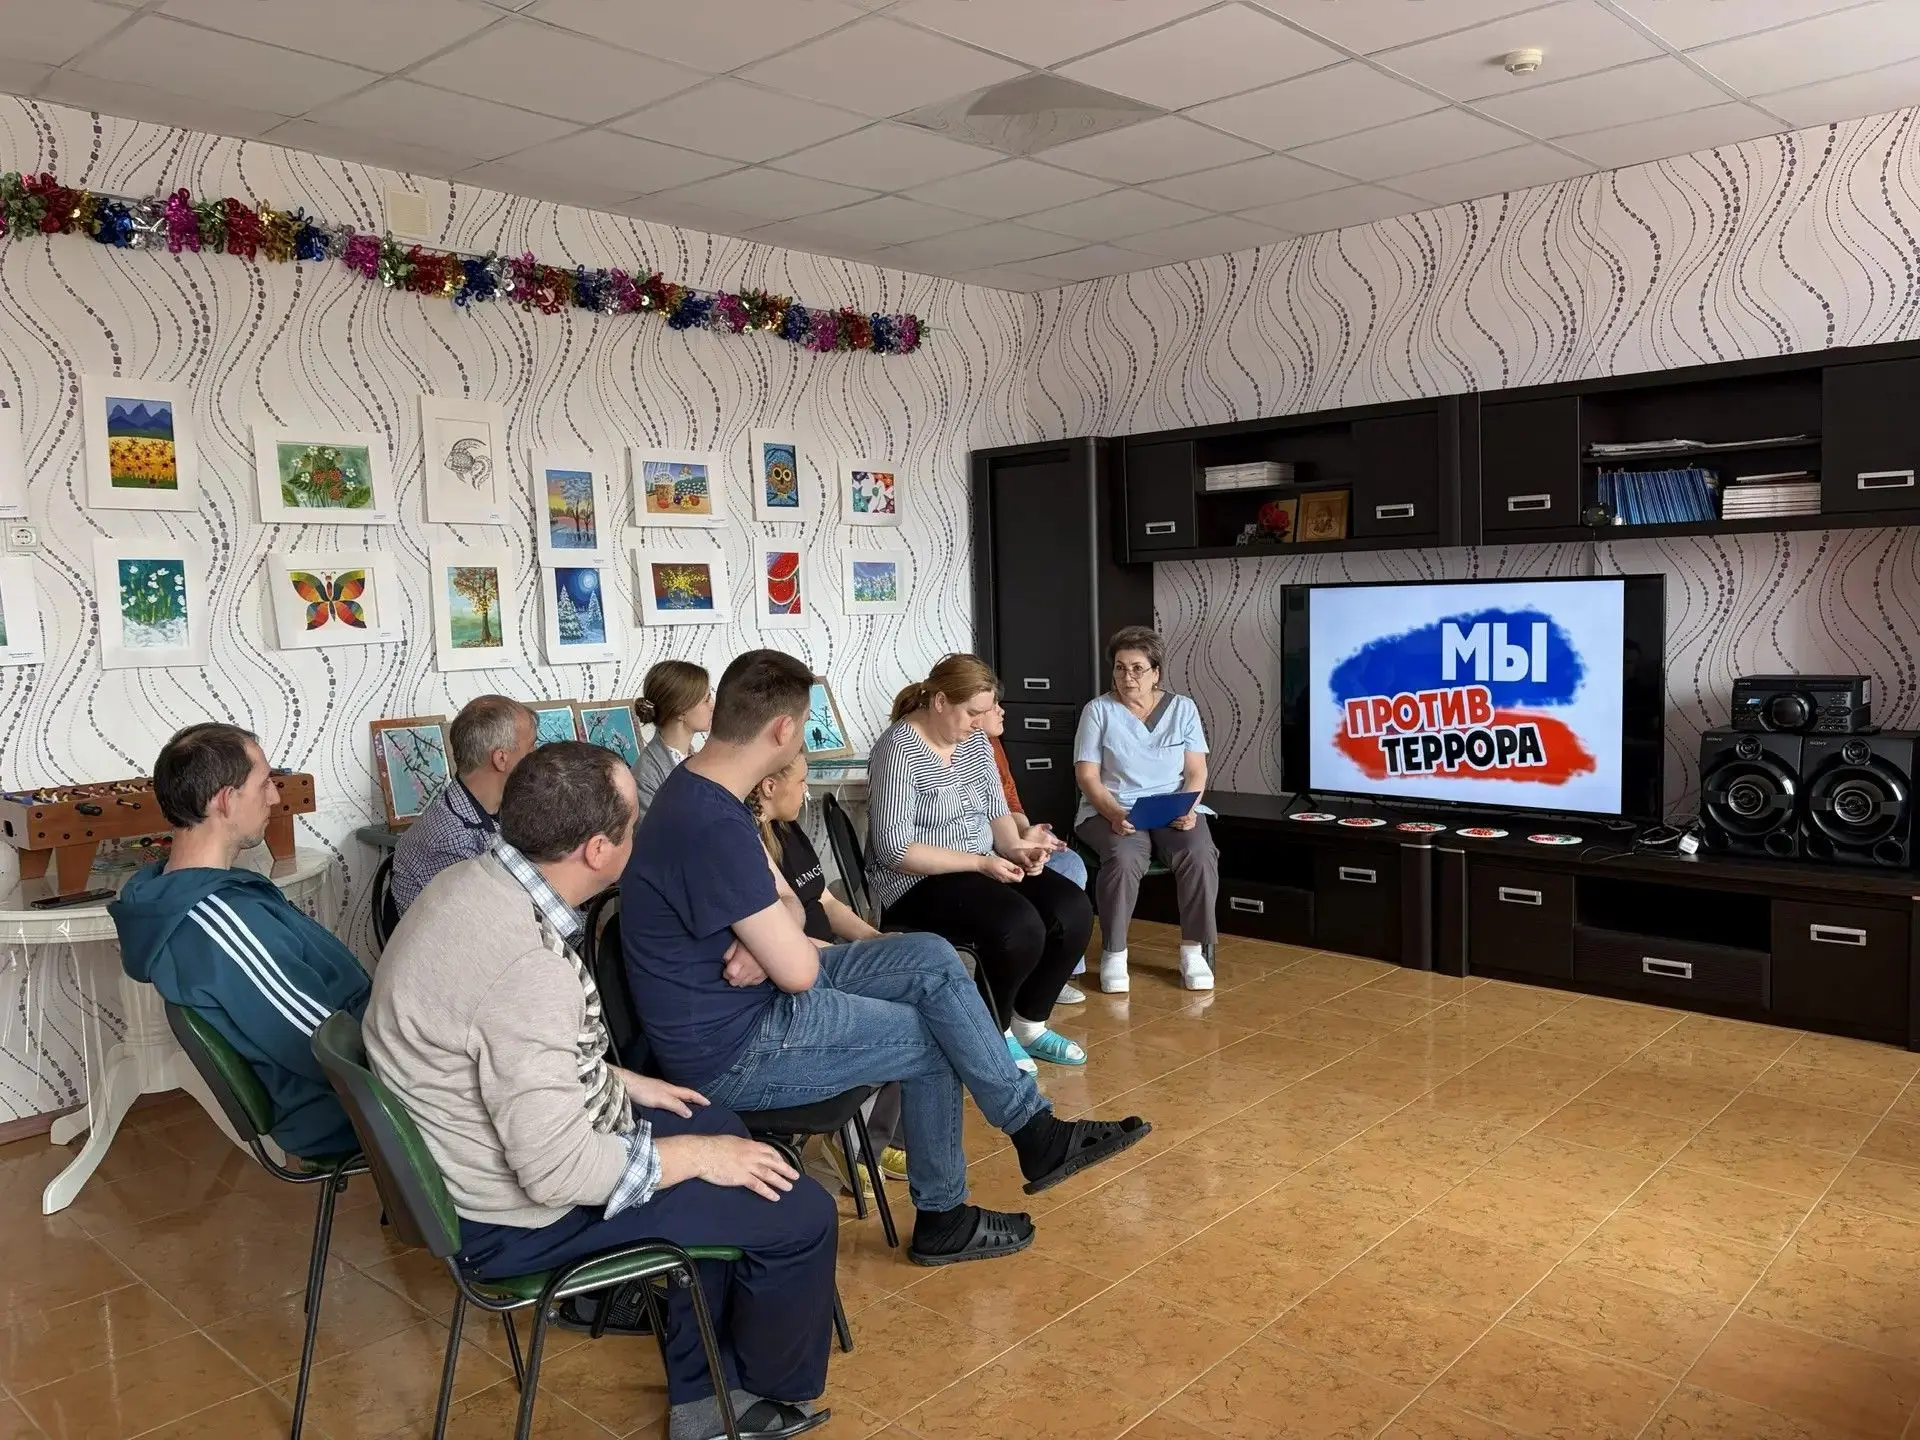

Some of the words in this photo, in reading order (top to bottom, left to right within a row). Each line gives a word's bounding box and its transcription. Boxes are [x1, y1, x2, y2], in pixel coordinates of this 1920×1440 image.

[1441, 622, 1548, 683] МЫ
[1346, 687, 1492, 736] ПРОТИВ
[1381, 726, 1544, 773] ТЕРРОРА
